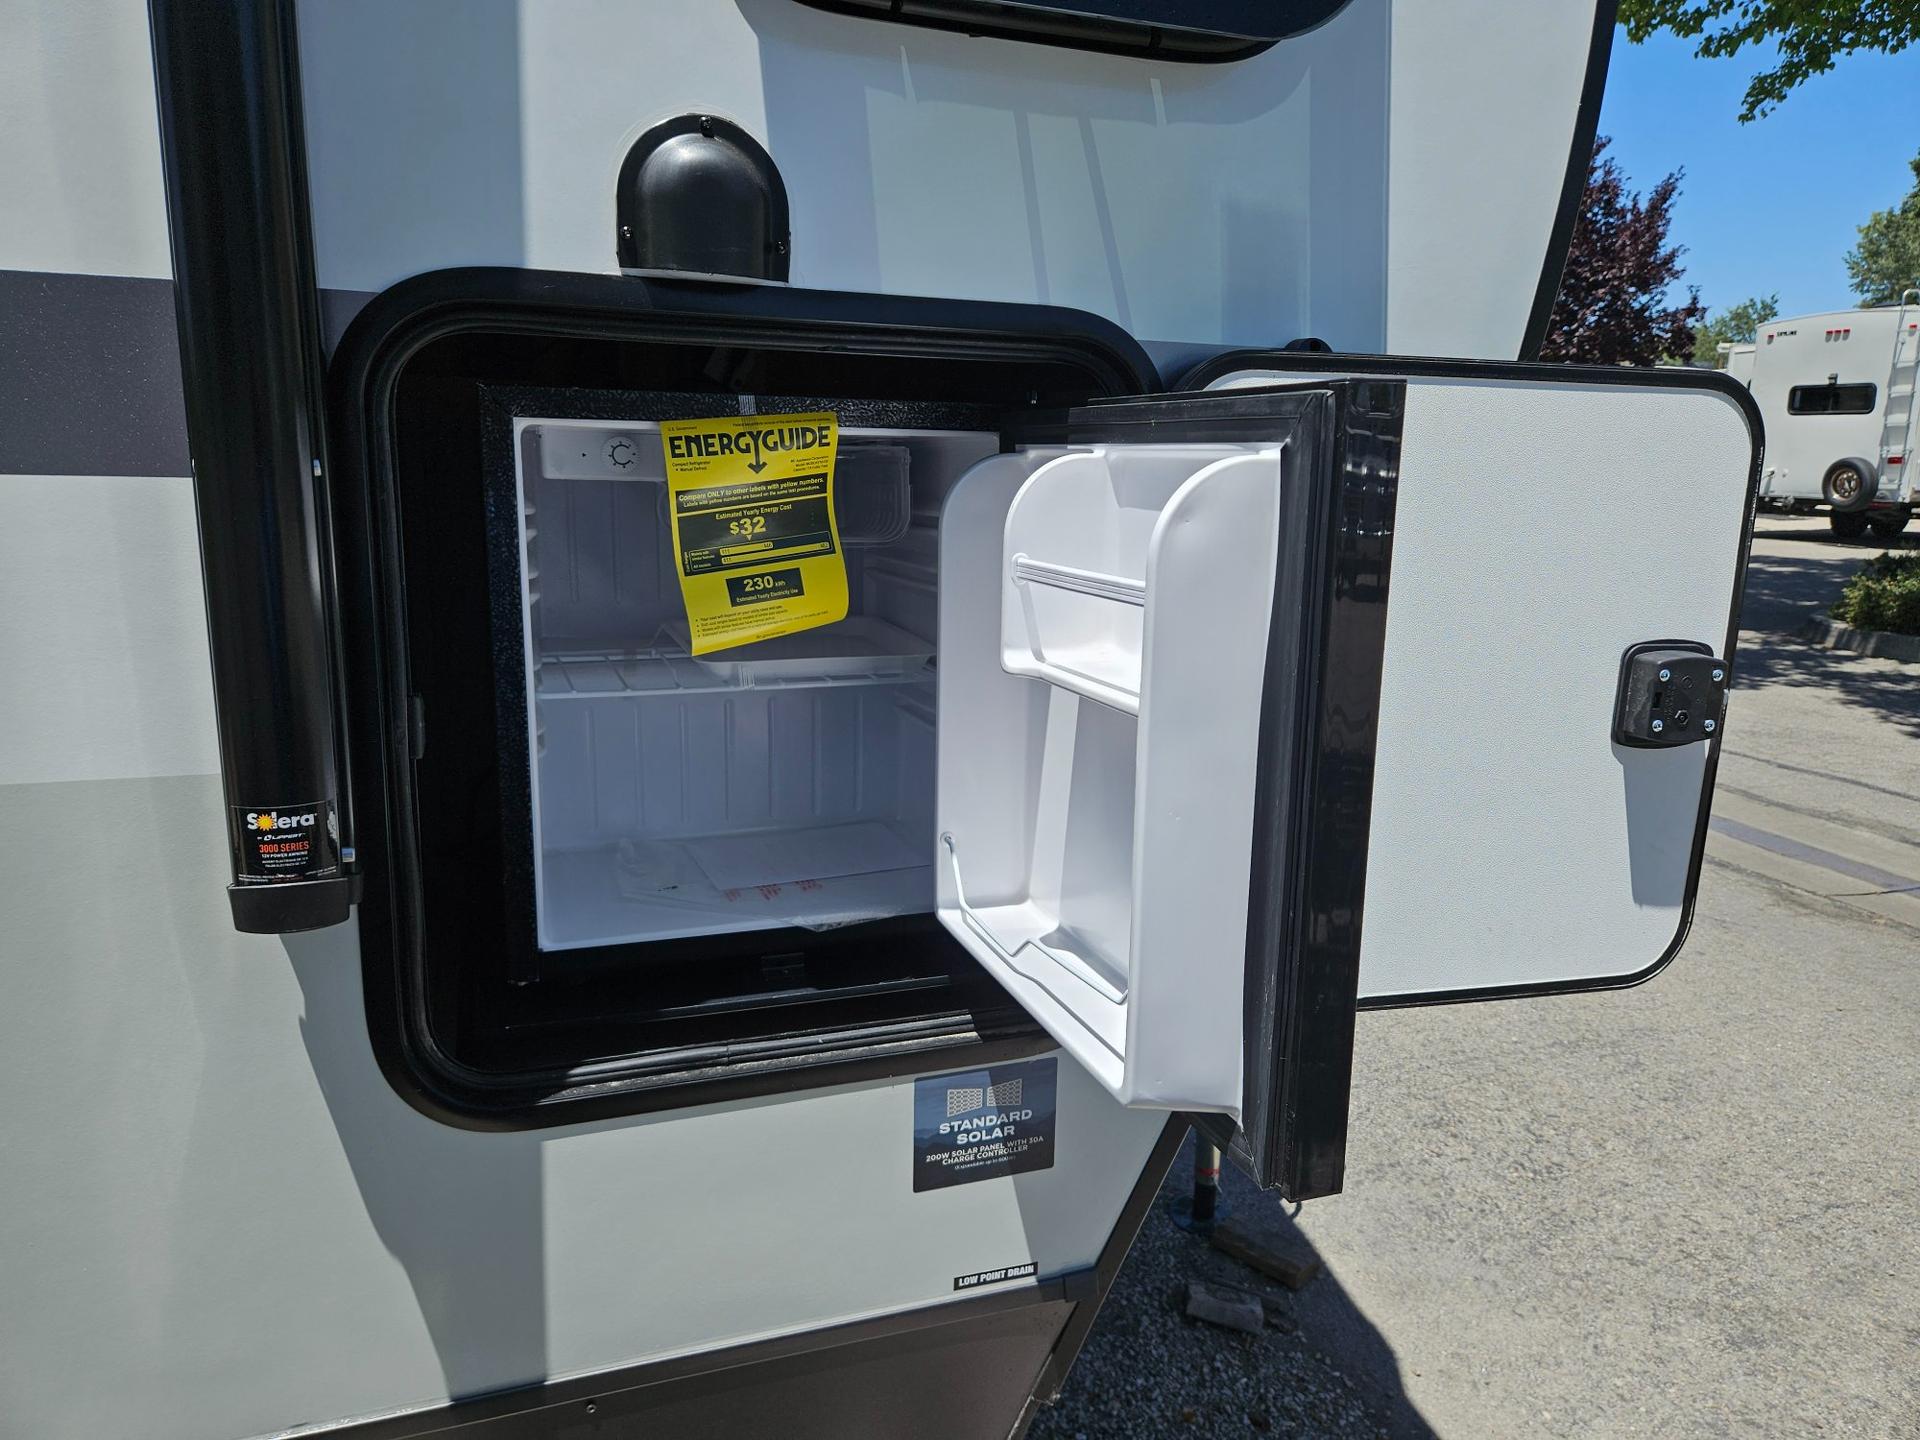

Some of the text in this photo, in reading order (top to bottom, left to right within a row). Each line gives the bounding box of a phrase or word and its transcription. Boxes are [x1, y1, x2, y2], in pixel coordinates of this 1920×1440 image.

[669, 425, 830, 459] ENERGYGUIDE
[679, 493, 707, 503] Compare
[707, 489, 725, 498] ONLY
[780, 480, 798, 489] yellow
[715, 503, 792, 520] Estimated Yearly Energy Cost
[729, 516, 767, 536] $32
[743, 575, 774, 592] 230
[259, 841, 310, 853] 3000 SERIES
[939, 1109, 1033, 1134] STANDARD
[956, 1125, 1016, 1144] SOLAR
[926, 1151, 950, 1163] 200W
[951, 1146, 978, 1158] SOLAR
[979, 1142, 1005, 1153] PANEL
[1006, 1138, 1027, 1148] WITH
[942, 1153, 975, 1165] CHARGE
[976, 1144, 1029, 1159] CONTROLLER
[958, 1264, 1034, 1287] LOW POINT DRAIN
